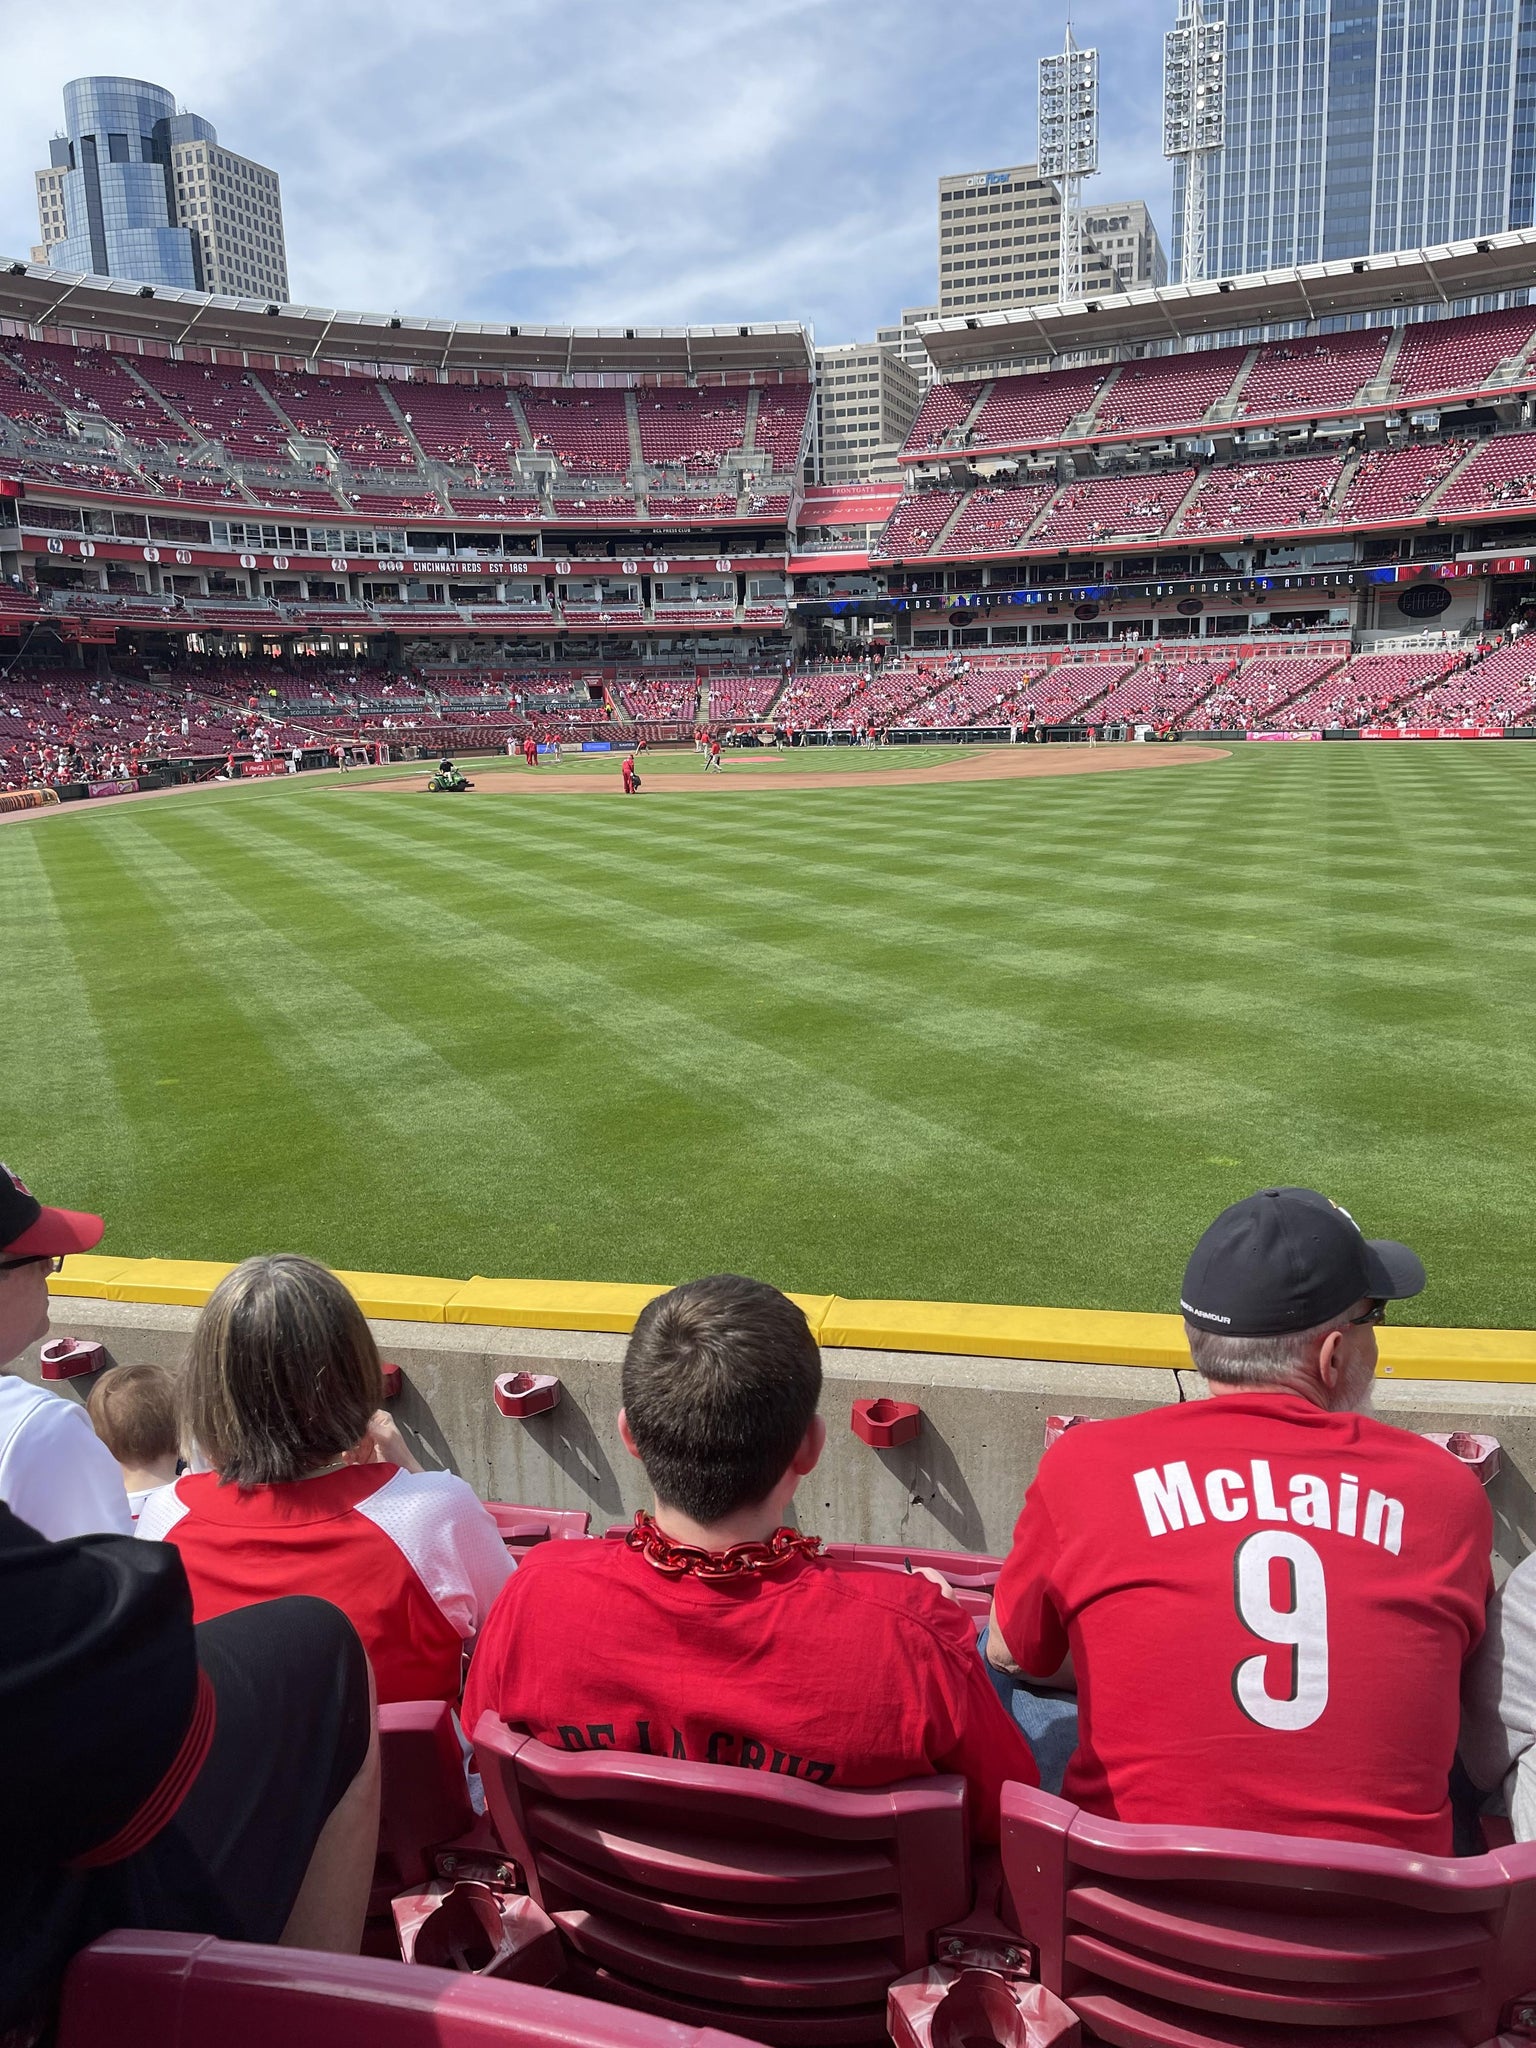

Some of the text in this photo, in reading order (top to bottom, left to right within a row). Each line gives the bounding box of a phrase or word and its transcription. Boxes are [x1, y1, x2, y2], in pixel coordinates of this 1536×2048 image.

[832, 486, 875, 495] FRONTGATE
[177, 550, 191, 564] 20
[413, 562, 528, 573] CINCINNATI REDS EST. 1869
[558, 562, 569, 574] 10
[624, 562, 635, 574] 13
[719, 560, 730, 572] 14
[1146, 574, 1354, 596] LOS ANGELES ANGELS
[905, 600, 931, 610] LOS
[1026, 590, 1086, 603] ANGELS
[1194, 1308, 1232, 1325] ARMOUR
[1133, 1459, 1405, 1556] McLain
[1231, 1530, 1329, 1731] 9
